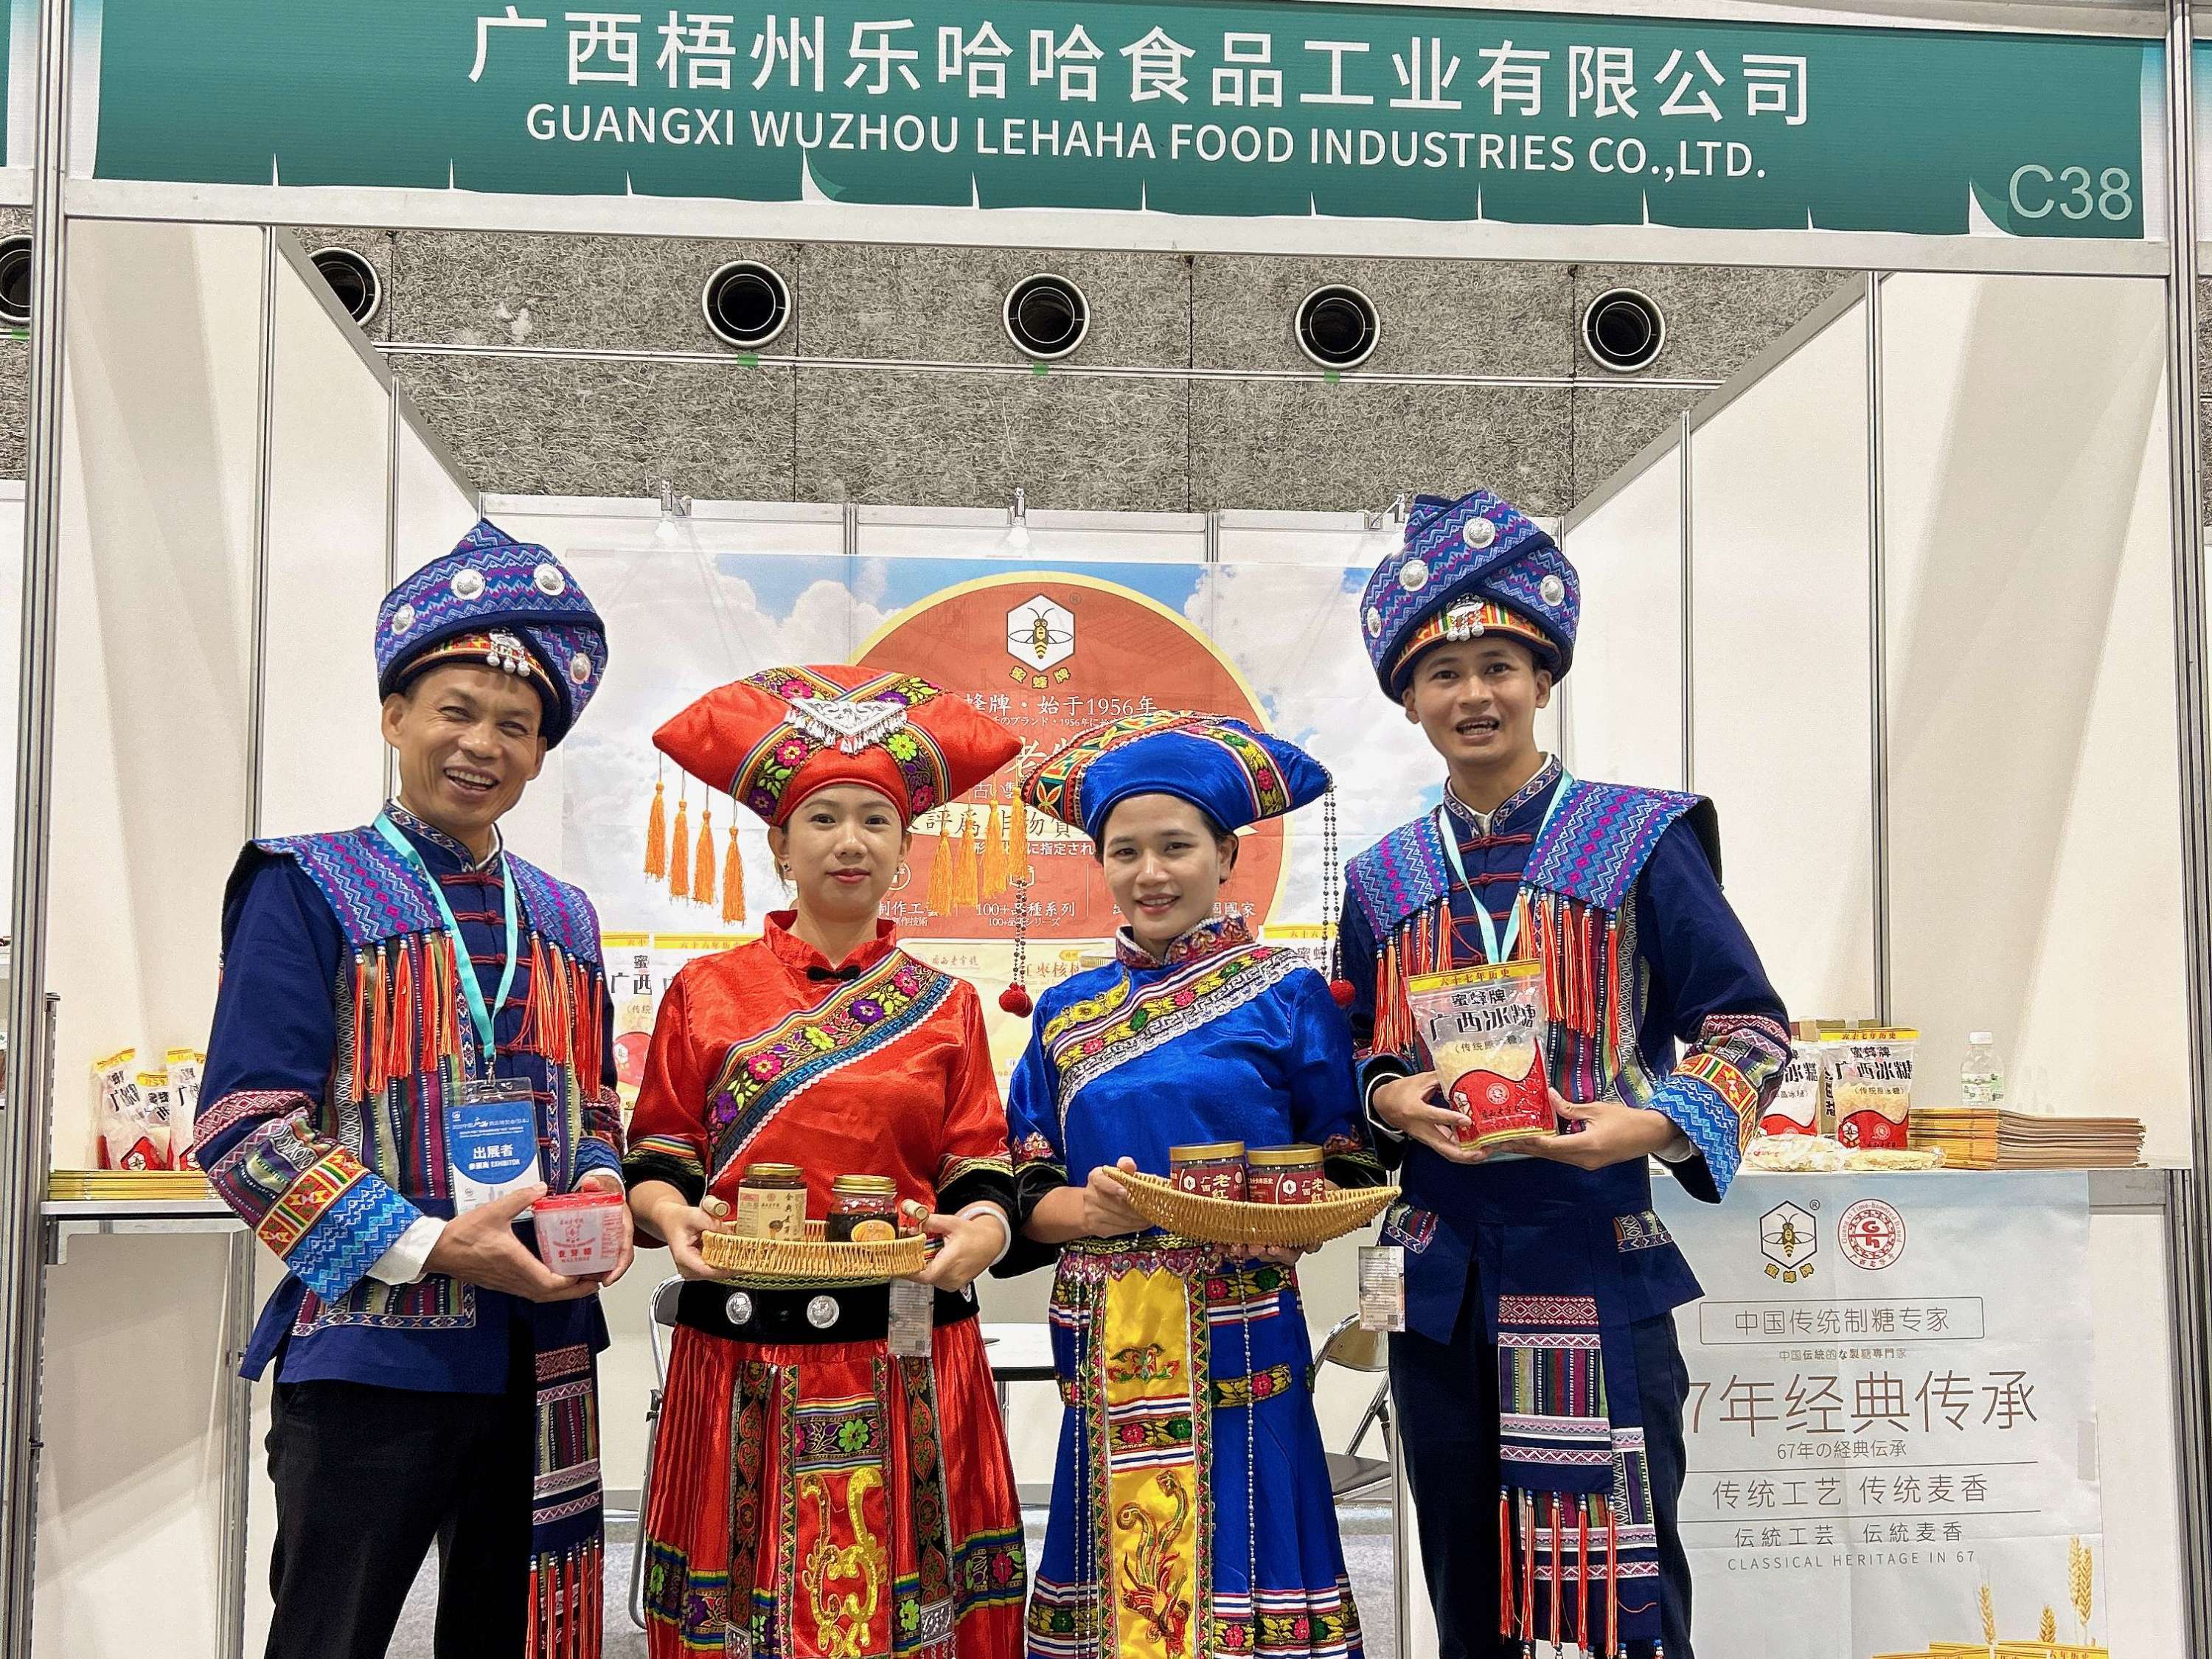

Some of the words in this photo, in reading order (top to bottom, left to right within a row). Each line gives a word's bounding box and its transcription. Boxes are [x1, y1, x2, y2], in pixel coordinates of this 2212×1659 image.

[468, 5, 1808, 126] 广西梧州乐哈哈食品工业有限公司
[526, 103, 734, 147] GUANGXI
[751, 110, 959, 154] WUZHOU
[976, 116, 1157, 160] LEHAHA
[1170, 123, 1295, 164] FOOD
[1311, 127, 1574, 173] INDUSTRIES
[2009, 164, 2133, 221] C38
[473, 1144, 514, 1160] 出展者
[1734, 1306, 1950, 1337] 中国传统制糖专家
[1777, 1439, 1907, 1460] 67年の経典伝承
[1712, 1477, 1843, 1510] 传统工艺
[1859, 1473, 1989, 1506] 传统麦香
[1734, 1524, 1835, 1548] 伝統工芸
[1863, 1520, 1964, 1545] 伝統麦香
[1728, 1556, 1823, 1571] CLASSICAL
[1832, 1552, 1920, 1567] HERITAGE
[1928, 1551, 1947, 1564] IN
[1956, 1549, 1977, 1563] 67
